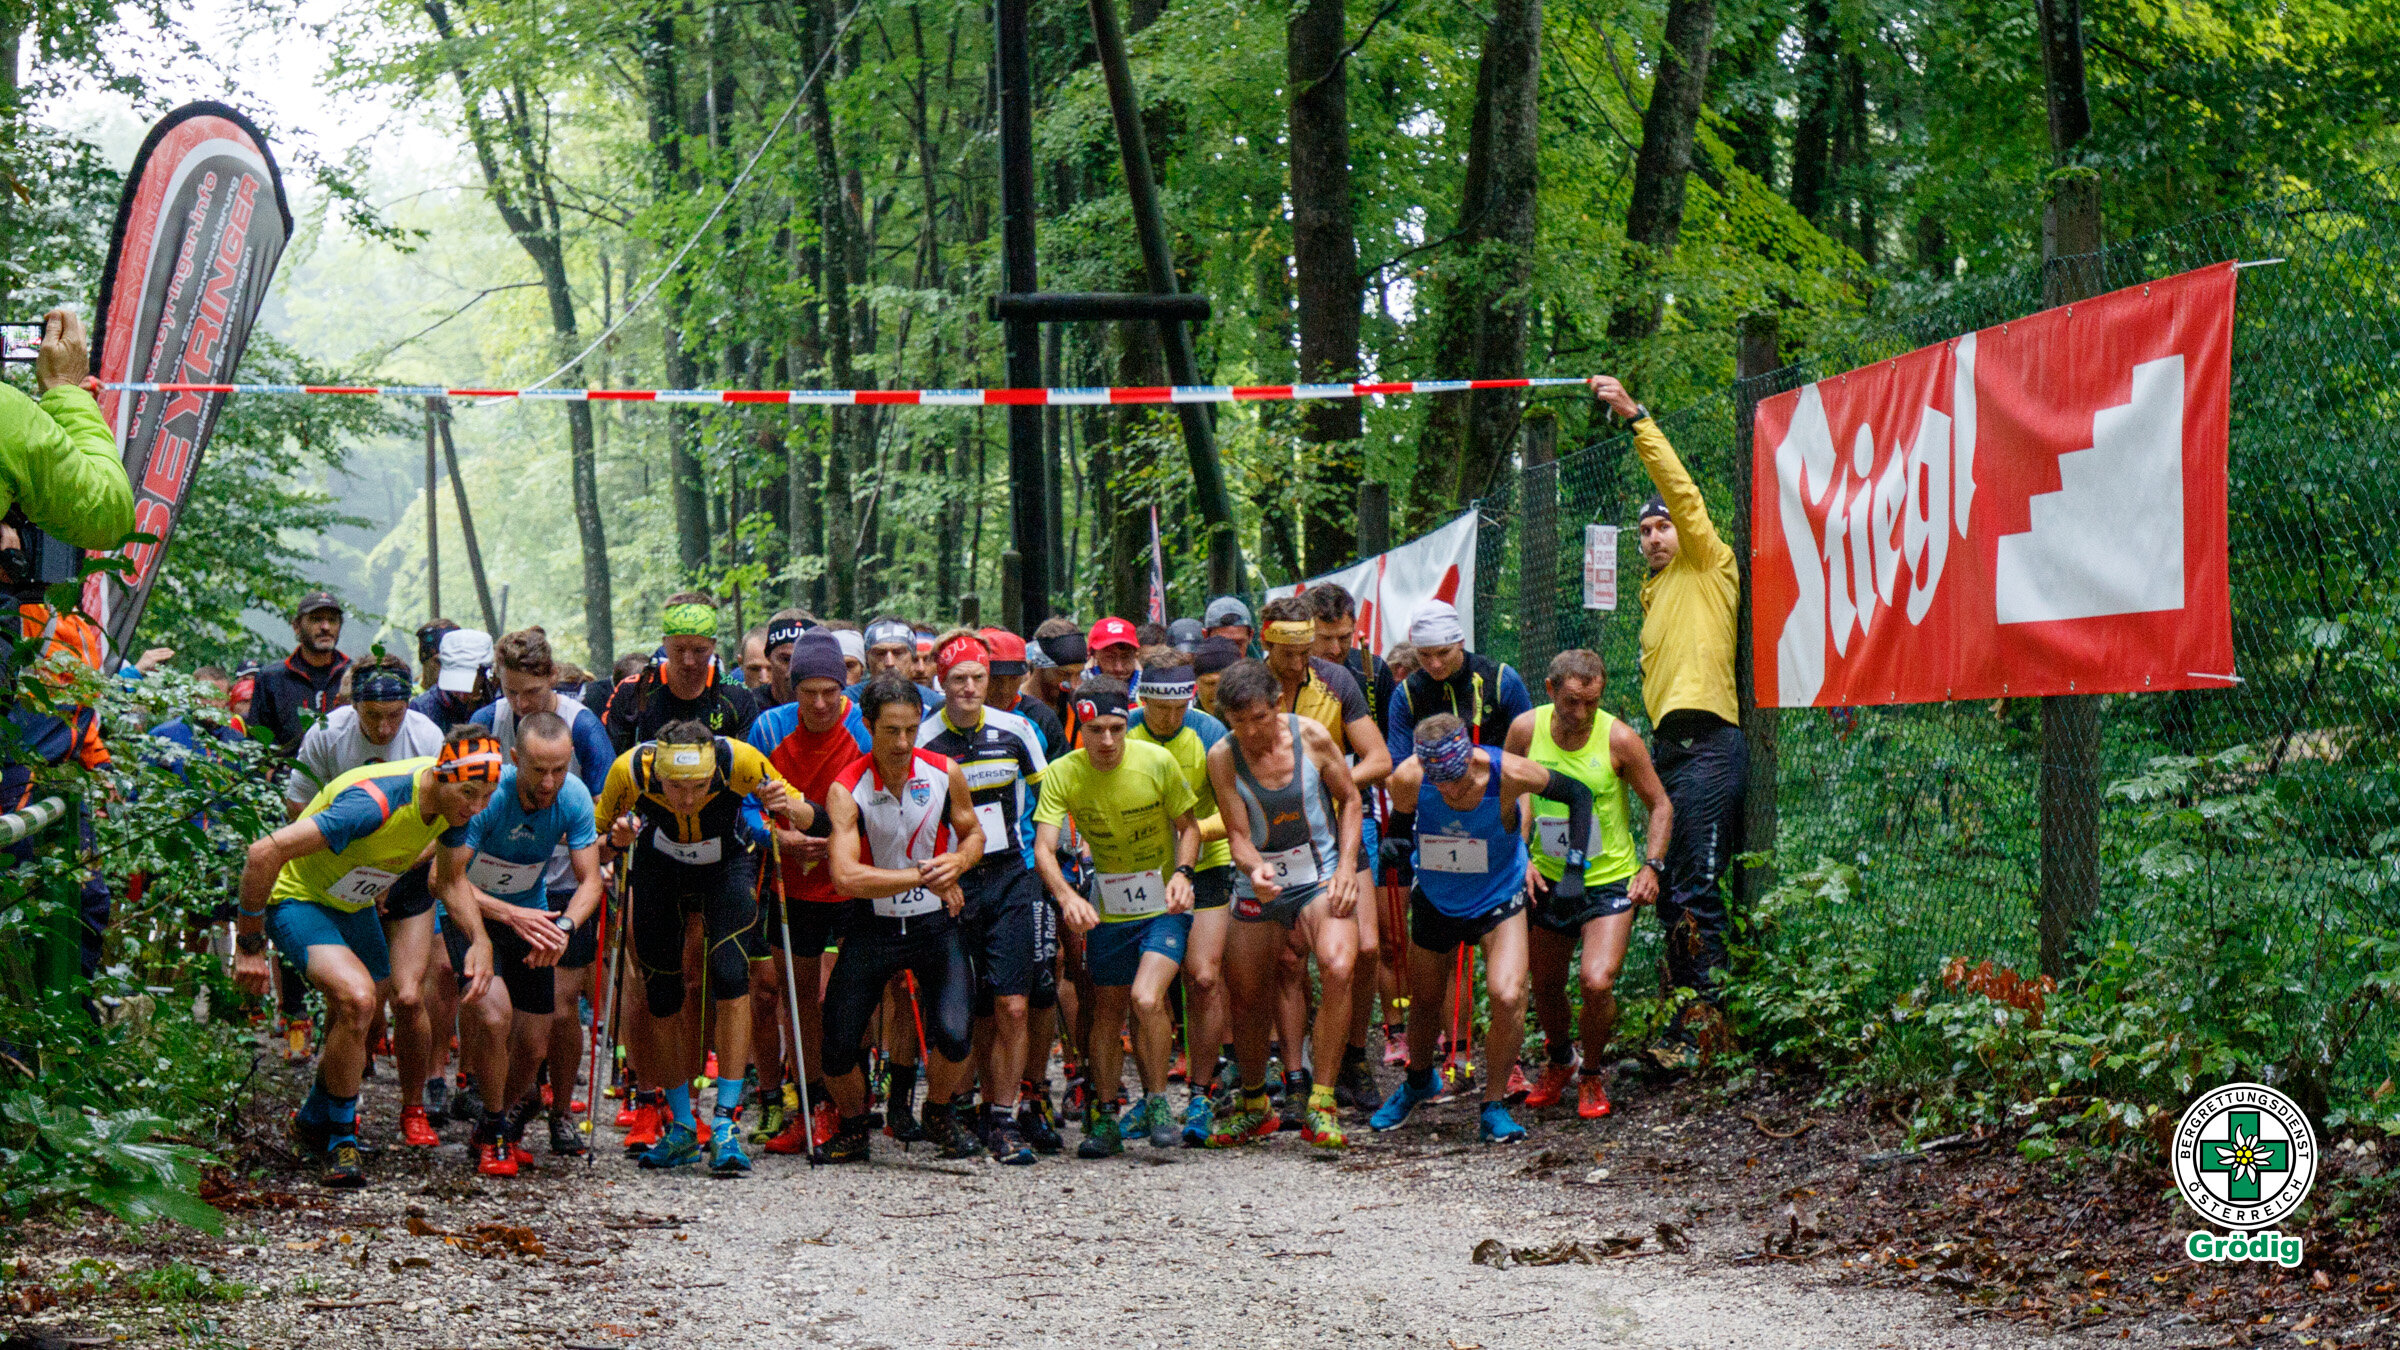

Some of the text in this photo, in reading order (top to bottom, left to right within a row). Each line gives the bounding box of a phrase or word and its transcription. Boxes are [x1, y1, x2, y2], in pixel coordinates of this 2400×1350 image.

[128, 170, 218, 439] www.seyringer.info
[119, 171, 260, 593] SEYRINGER
[1775, 332, 1978, 707] Stiegl
[1557, 832, 1568, 847] 4
[1449, 850, 1457, 862] 1
[1276, 862, 1288, 878] 3
[497, 873, 513, 886] 2
[892, 886, 924, 905] 128
[1123, 886, 1147, 903] 14
